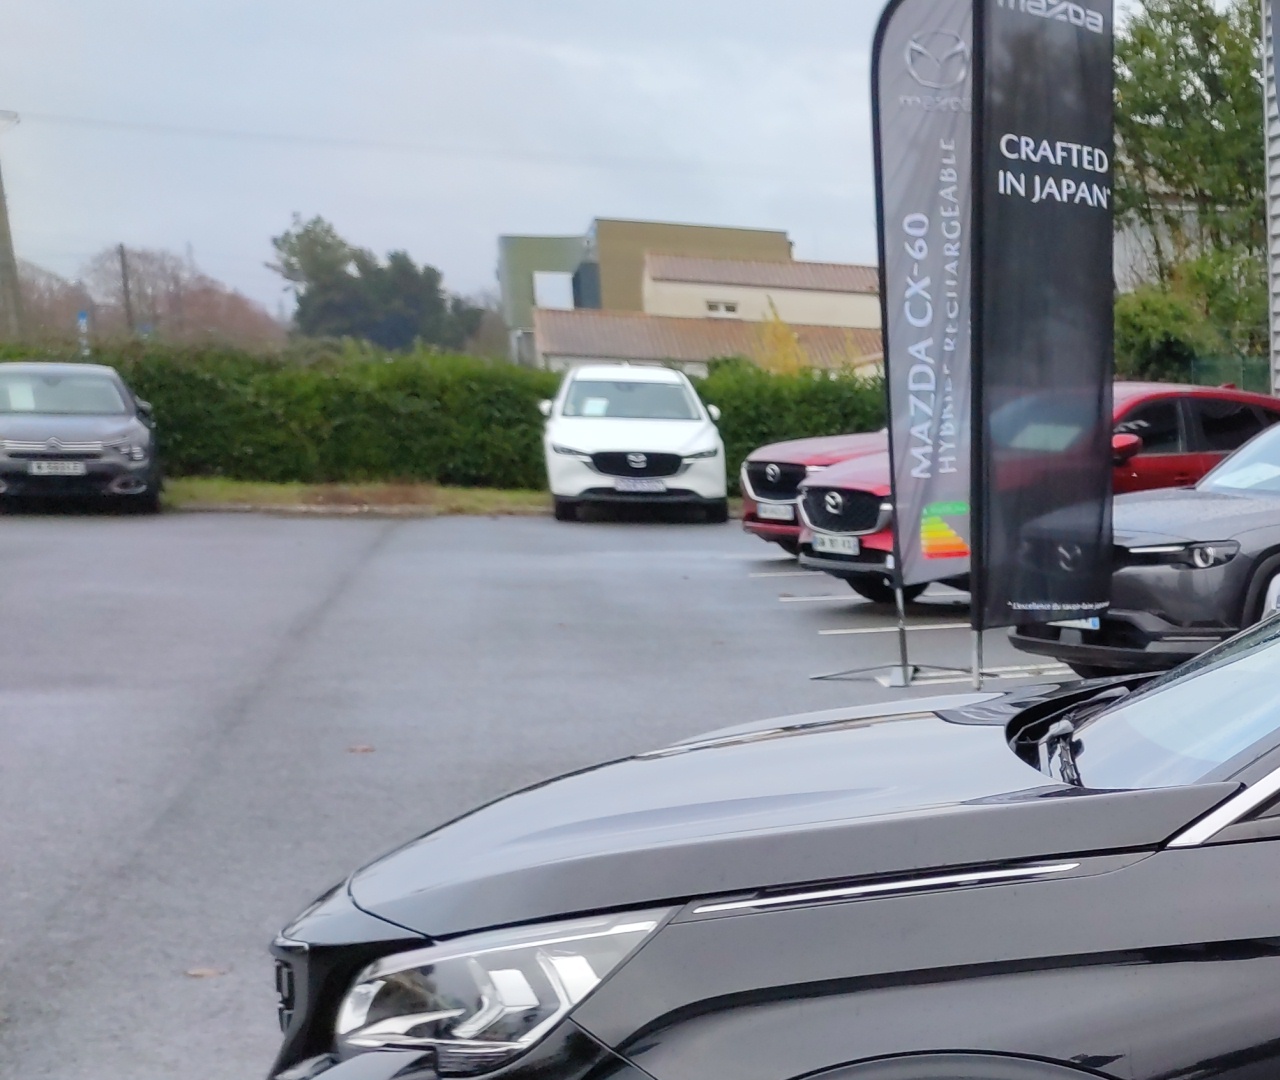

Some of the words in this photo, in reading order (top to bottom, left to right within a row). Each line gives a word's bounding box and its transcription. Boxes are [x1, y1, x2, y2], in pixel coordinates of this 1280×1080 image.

[998, 170, 1026, 197] IN
[1000, 133, 1109, 174] CRAFTED
[902, 212, 933, 328] CX-60
[907, 337, 937, 479] MAZDA
